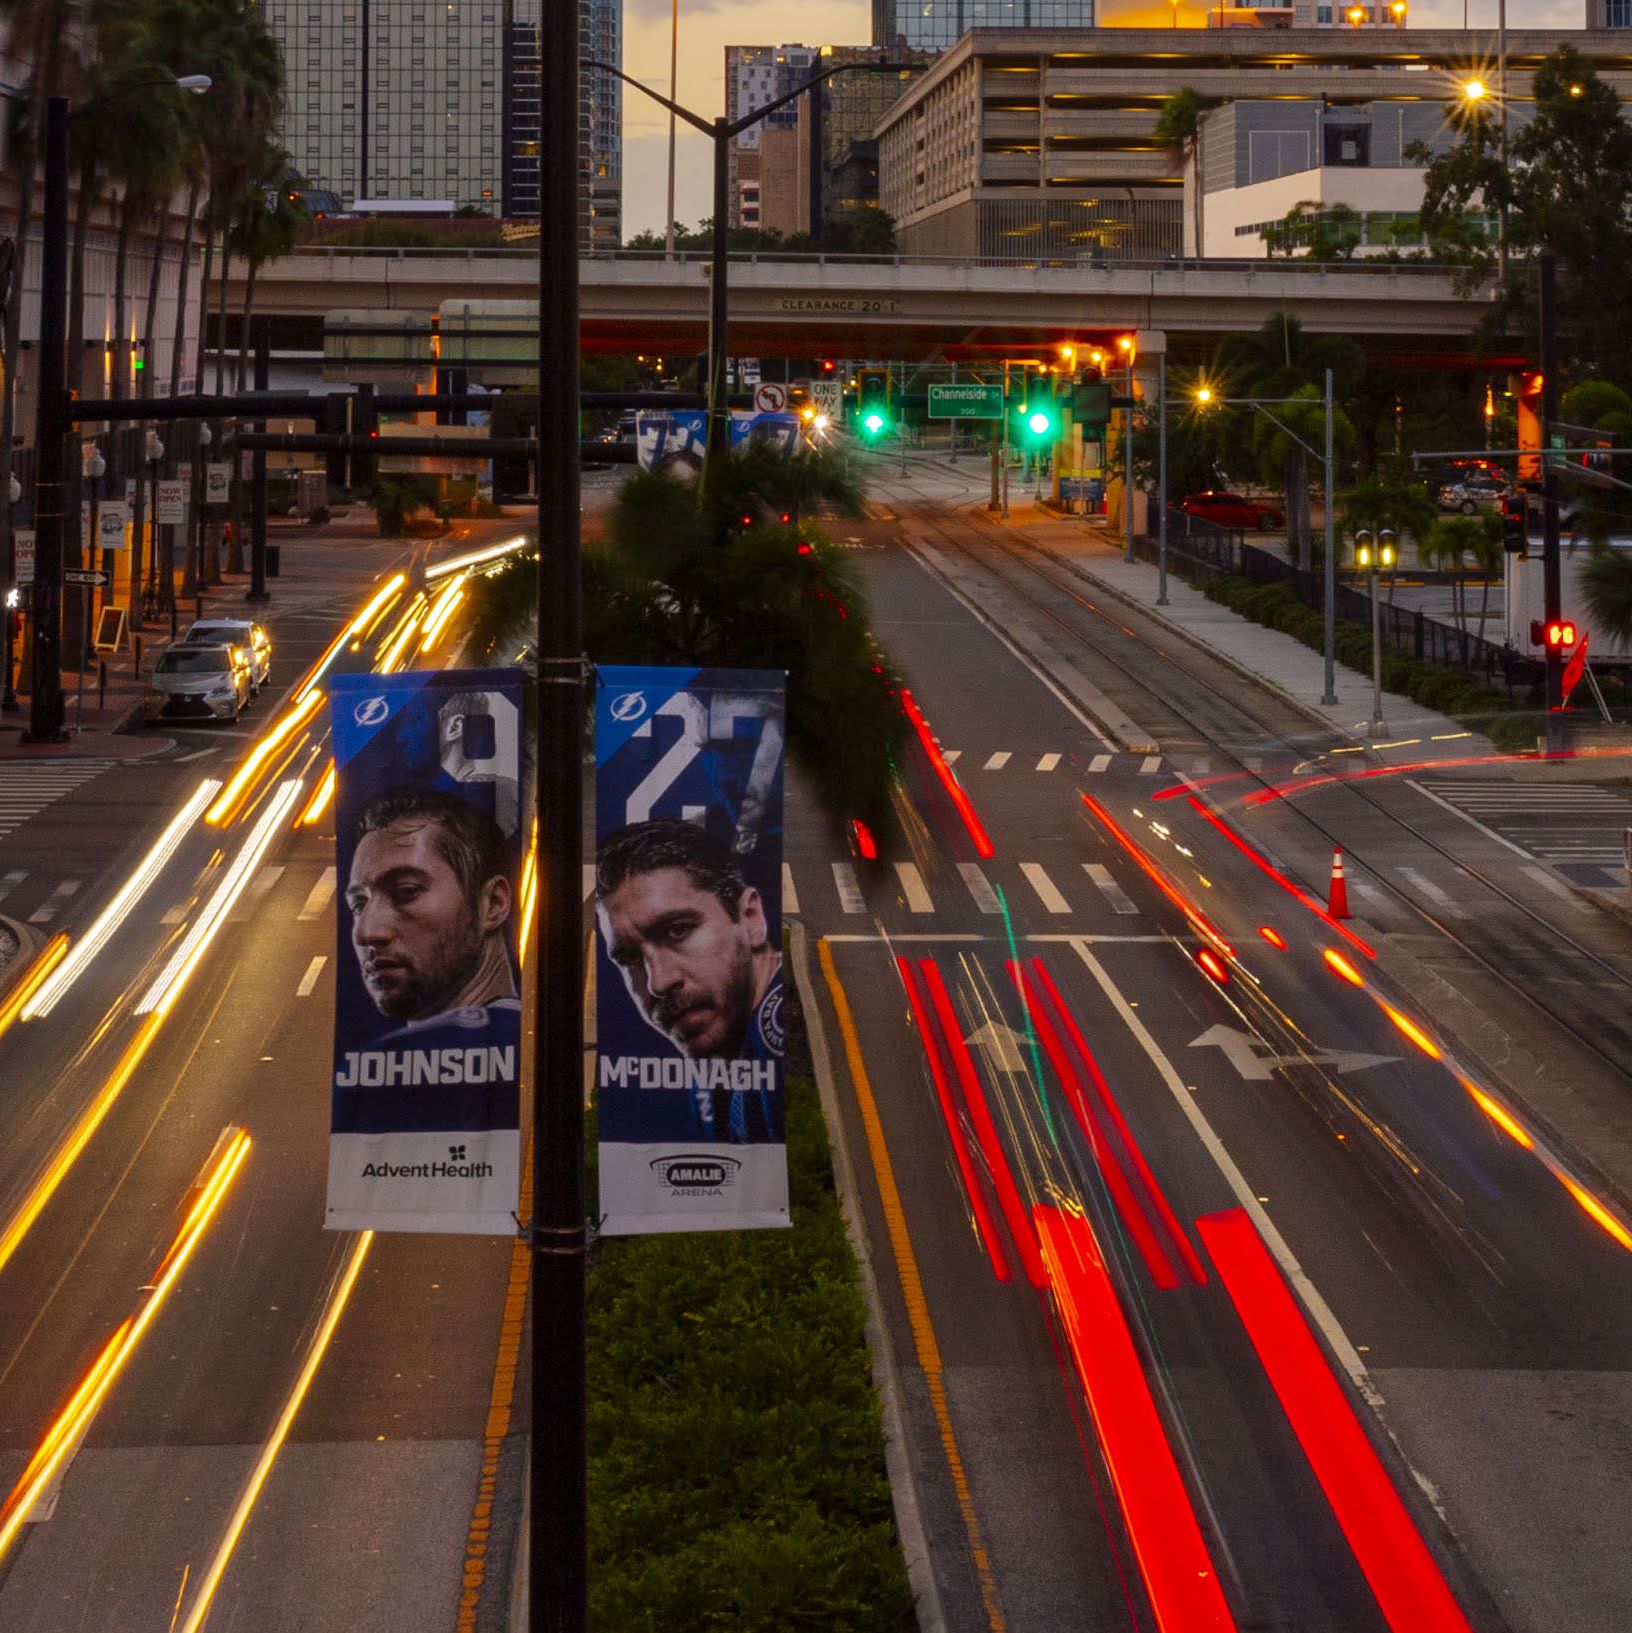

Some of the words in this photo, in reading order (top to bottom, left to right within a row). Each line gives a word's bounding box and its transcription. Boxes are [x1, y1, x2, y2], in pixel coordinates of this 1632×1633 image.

[782, 299, 856, 311] CLEARANCE
[814, 383, 837, 395] ONE
[931, 387, 987, 400] Channelside
[814, 396, 837, 406] WAY
[959, 407, 976, 416] 300
[160, 487, 181, 495] NOW
[159, 495, 182, 503] OPEN
[17, 539, 33, 549] NO
[15, 549, 34, 558] OP
[625, 691, 785, 855] 27
[336, 1046, 515, 1088] JOHNSON
[362, 1160, 493, 1179] AdventHealth
[670, 1168, 723, 1181] AMALIE
[670, 1188, 724, 1197] ARENA
